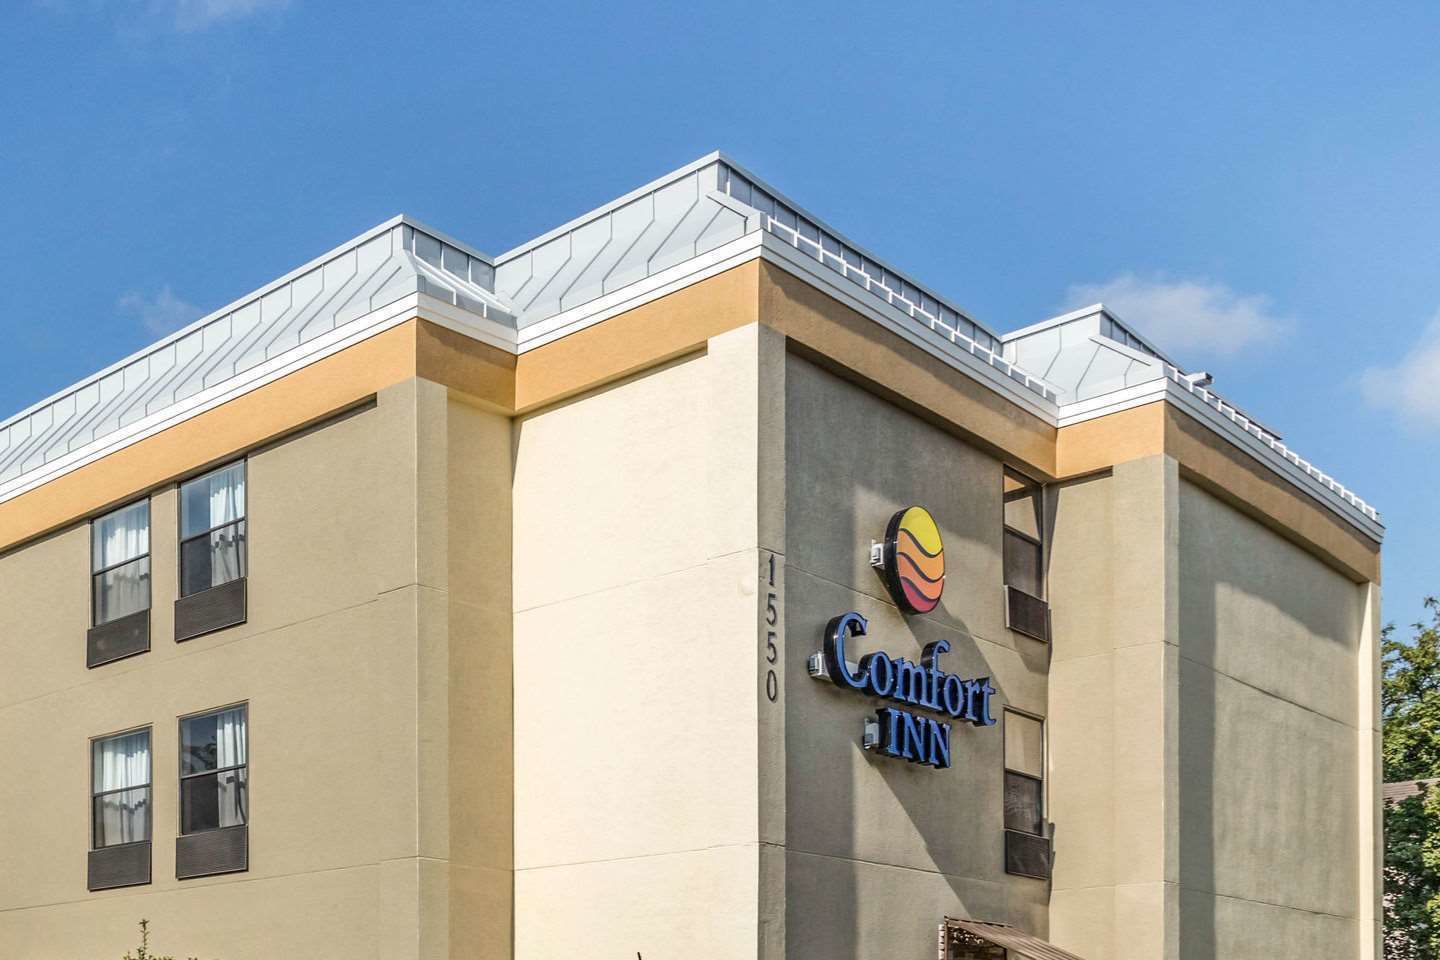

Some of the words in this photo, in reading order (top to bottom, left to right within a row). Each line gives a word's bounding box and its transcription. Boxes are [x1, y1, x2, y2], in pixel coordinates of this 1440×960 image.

[766, 554, 777, 702] 1550
[823, 611, 997, 726] Comfort
[874, 707, 952, 769] INN
